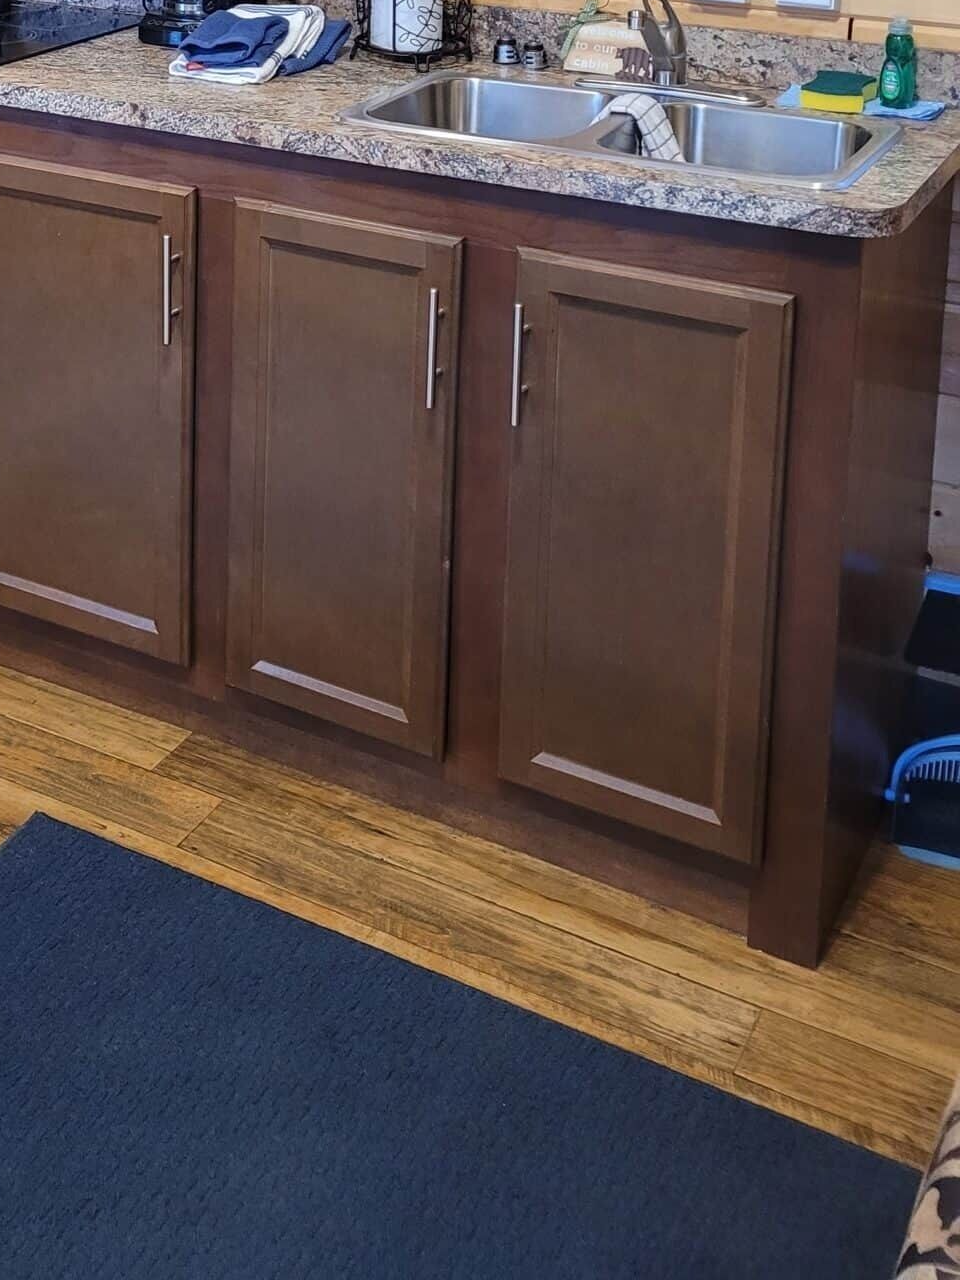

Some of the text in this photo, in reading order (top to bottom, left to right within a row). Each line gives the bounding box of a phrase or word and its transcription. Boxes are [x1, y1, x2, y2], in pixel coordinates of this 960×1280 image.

[575, 40, 617, 54] to our
[574, 55, 609, 71] cabin
